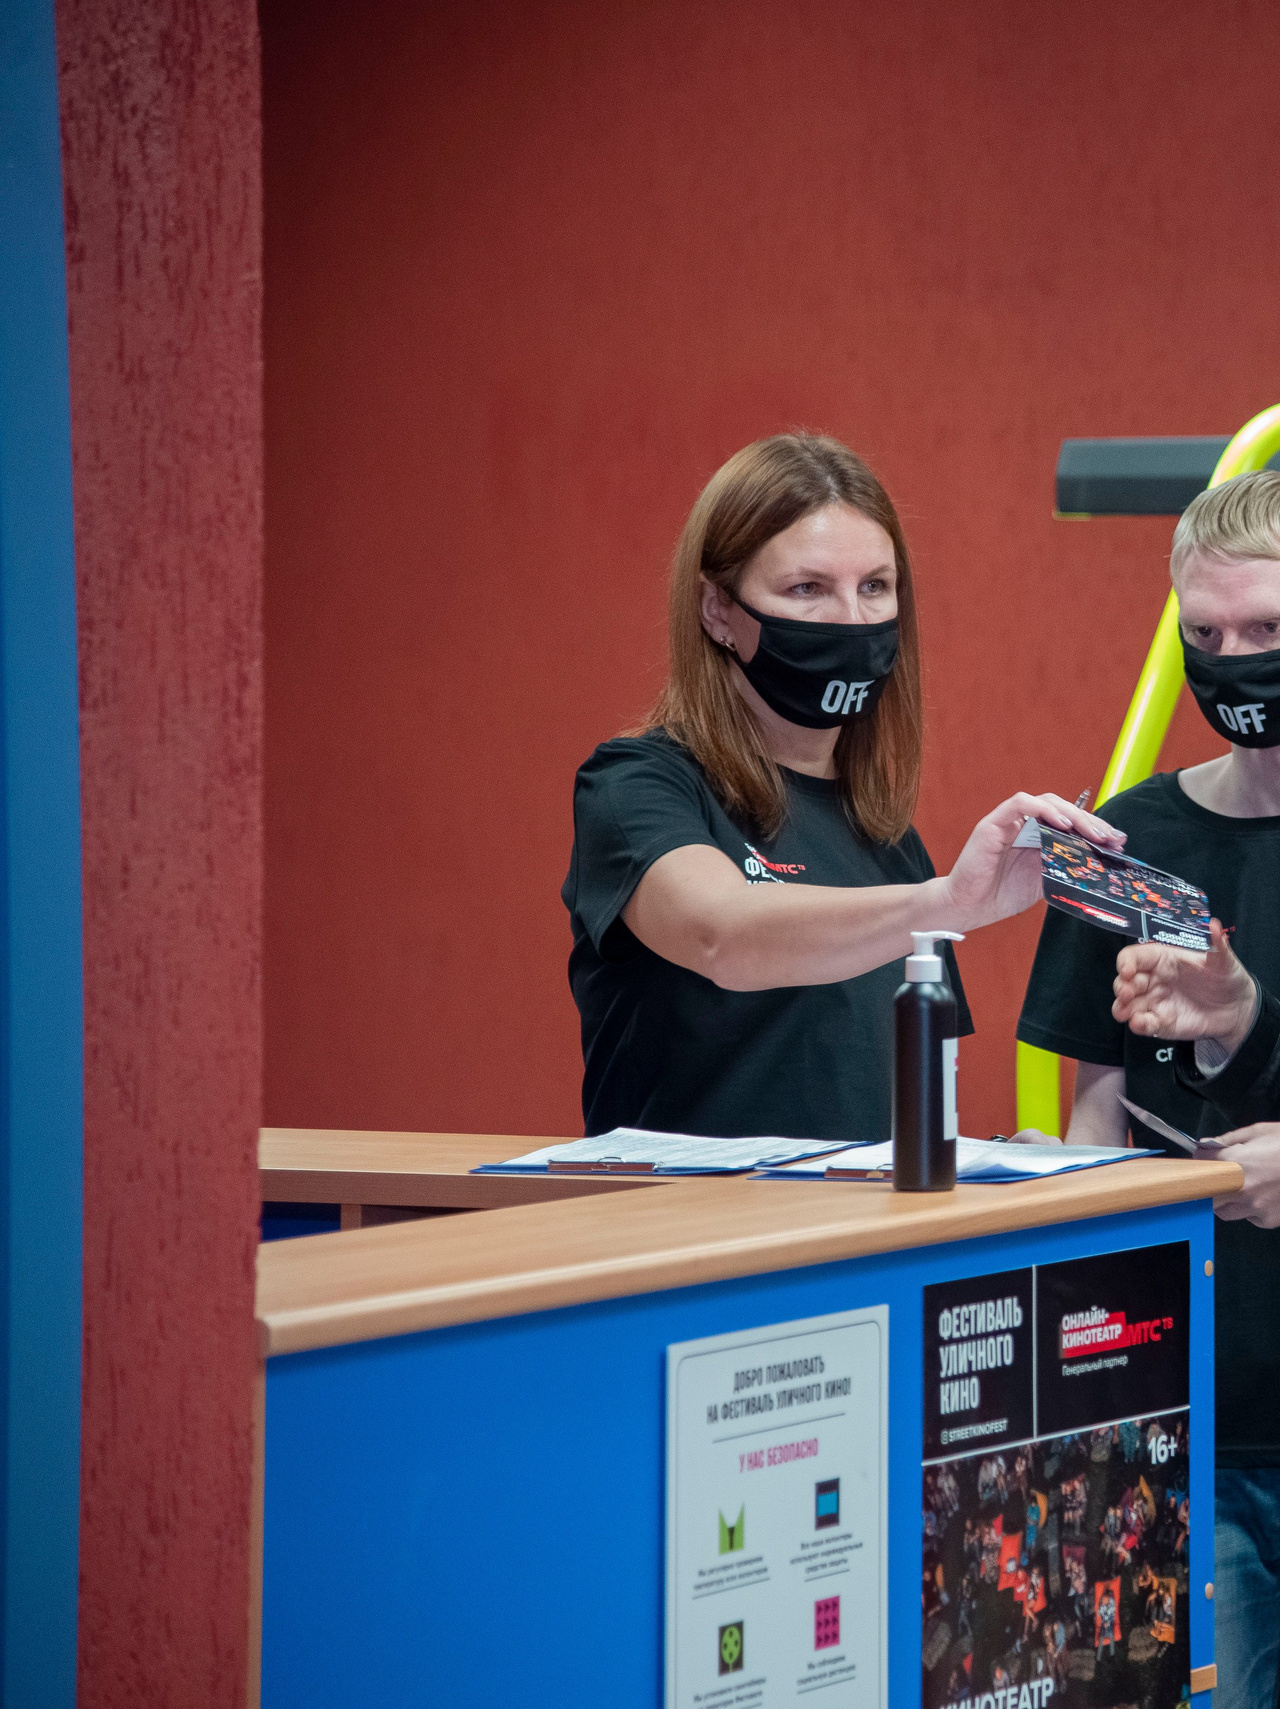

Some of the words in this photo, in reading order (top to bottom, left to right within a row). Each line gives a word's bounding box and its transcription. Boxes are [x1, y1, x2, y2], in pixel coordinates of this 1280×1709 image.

[820, 679, 876, 715] OFF
[1216, 703, 1267, 735] OFF
[939, 1296, 1023, 1340] ФЕСТИВАЛЬ
[1062, 1305, 1110, 1331] ОНЛАЙН-
[1062, 1323, 1122, 1349] КИНОТЕАТР
[1125, 1319, 1161, 1346] МТС
[939, 1333, 1014, 1378] УЛИЧНОГО
[733, 1367, 763, 1394] ДОБРО
[766, 1355, 825, 1384] ПОЖАЛОВАТЬ
[706, 1403, 719, 1425] НА
[721, 1393, 774, 1420] ФЕСТИВАЛЬ
[776, 1383, 822, 1410] УЛИЧНОГО
[824, 1377, 851, 1400] КИНО!
[940, 1376, 979, 1415] КИНО
[739, 1453, 745, 1473] У
[747, 1449, 764, 1471] НАС
[767, 1437, 818, 1467] БЕЗОПАСНО
[1147, 1434, 1178, 1465] 16+
